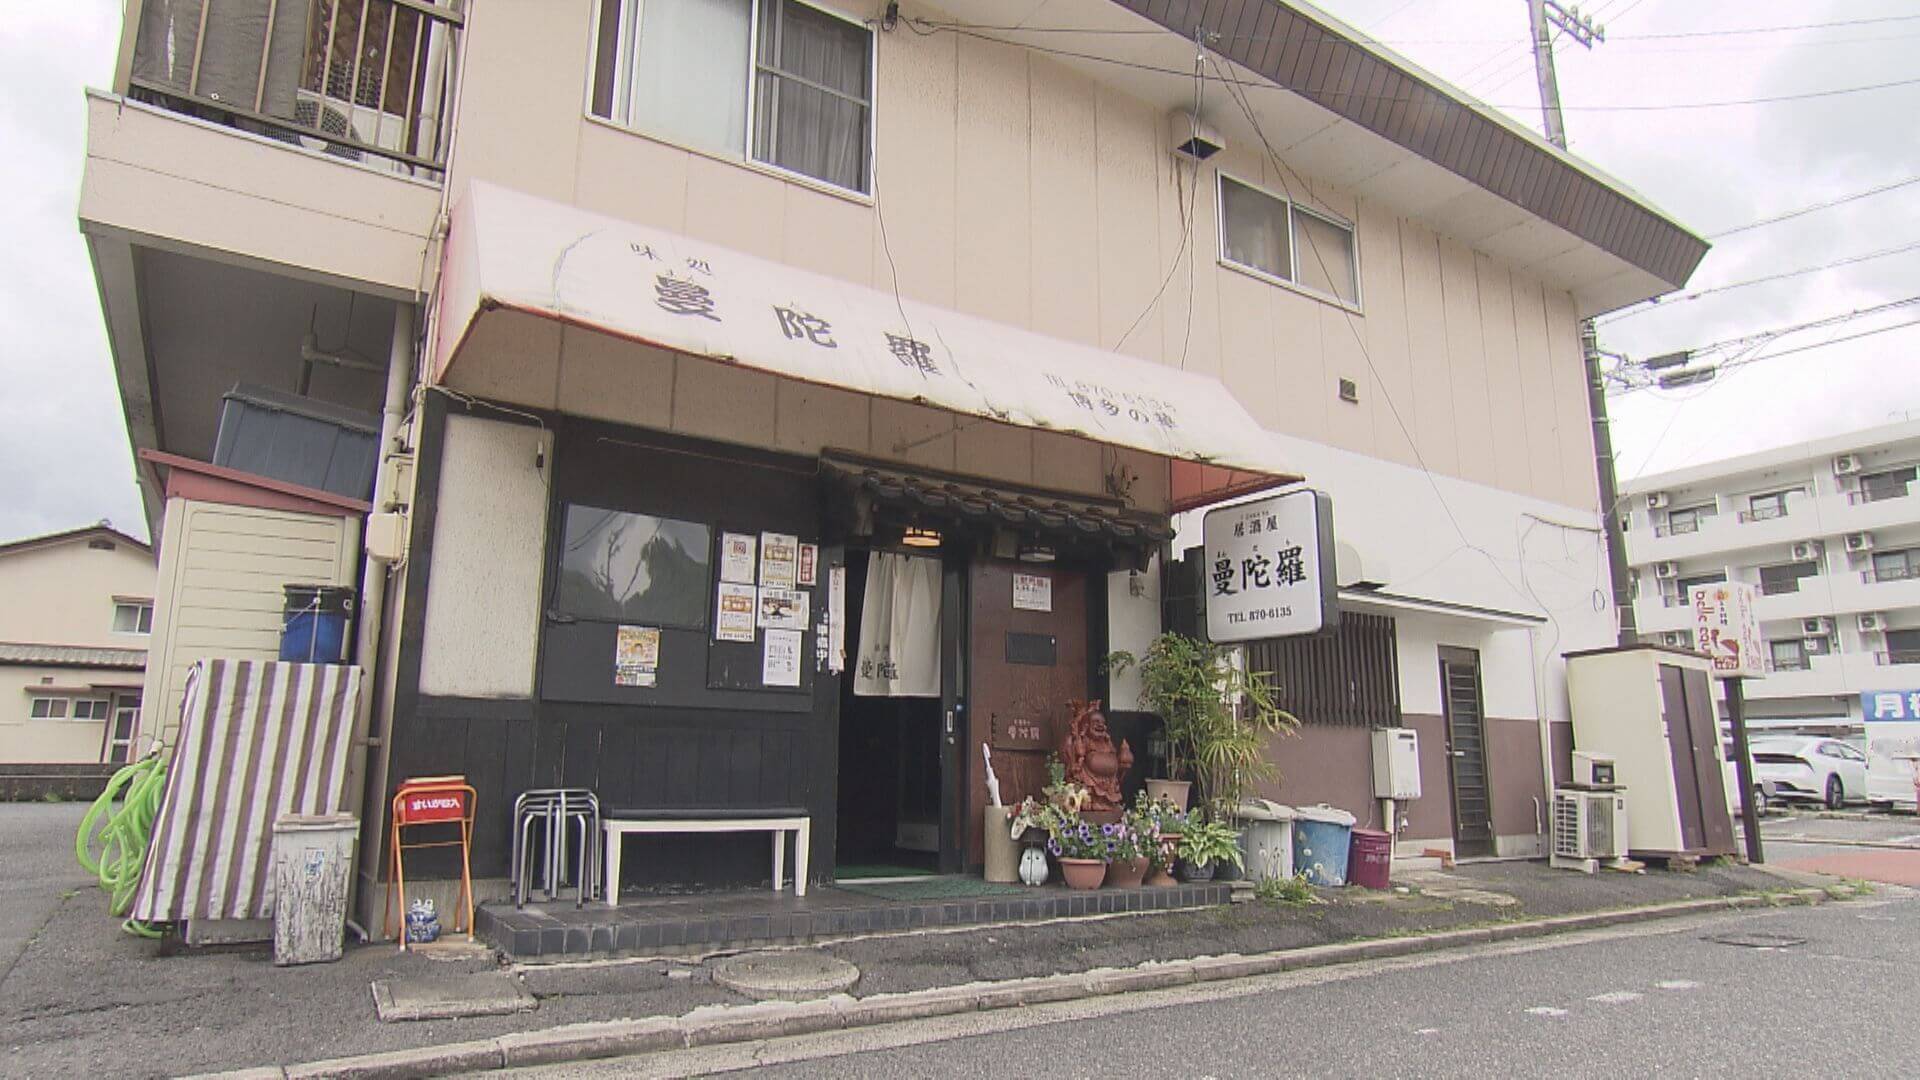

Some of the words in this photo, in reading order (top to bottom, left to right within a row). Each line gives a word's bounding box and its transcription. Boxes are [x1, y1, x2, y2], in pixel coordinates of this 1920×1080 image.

[629, 241, 712, 276] 味処
[654, 274, 943, 376] 曼陀羅
[1234, 515, 1278, 538] 居酒屋
[1212, 546, 1307, 597] 曼陀羅
[1228, 612, 1247, 625] TEL
[1249, 606, 1292, 621] 870-6135
